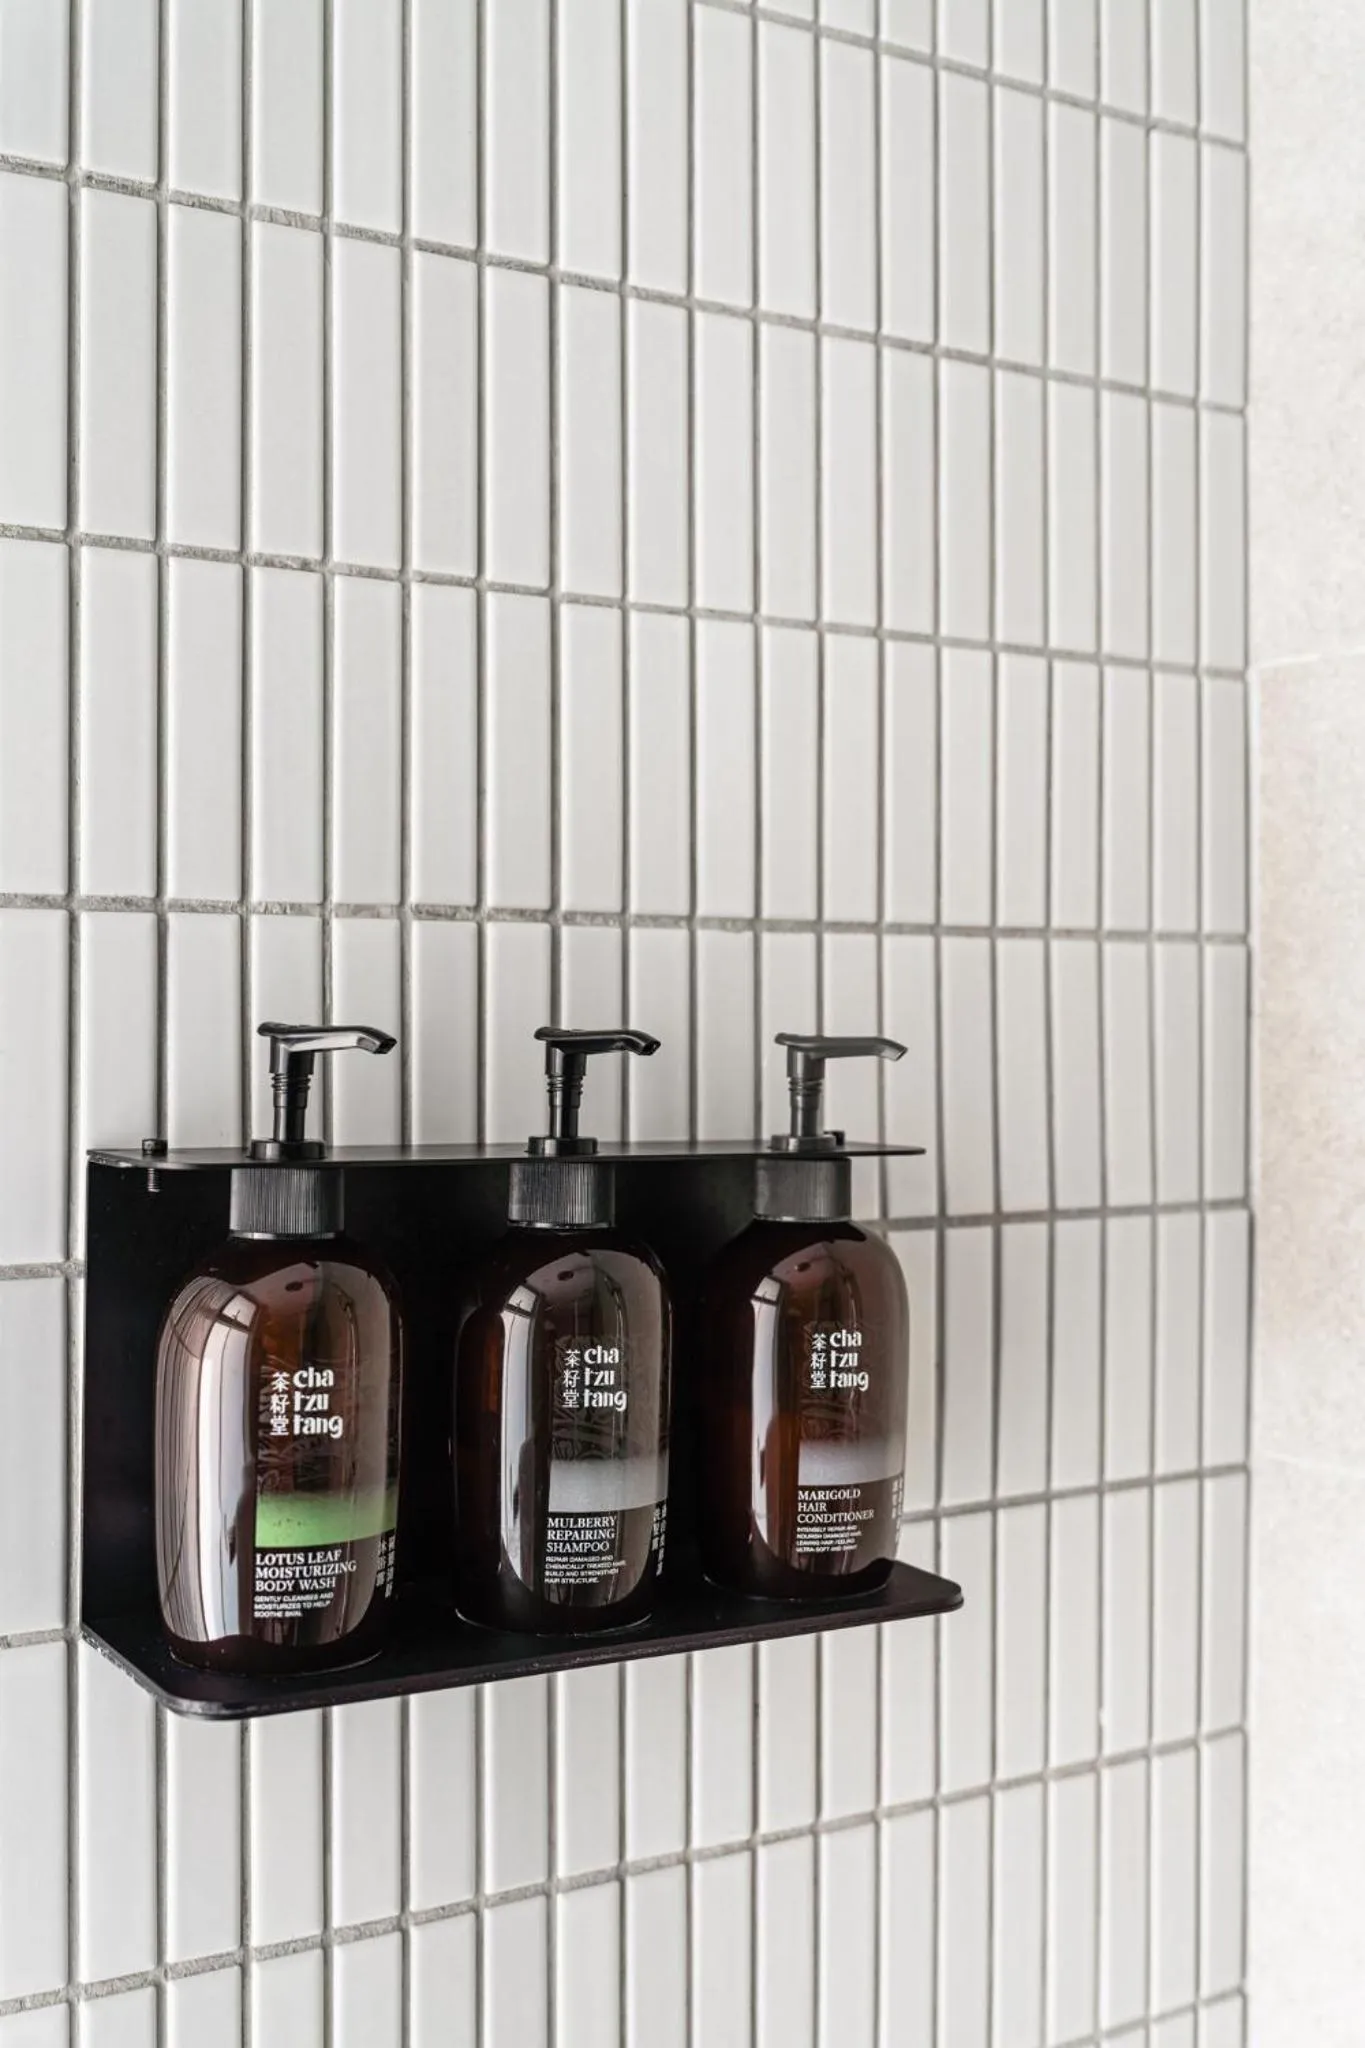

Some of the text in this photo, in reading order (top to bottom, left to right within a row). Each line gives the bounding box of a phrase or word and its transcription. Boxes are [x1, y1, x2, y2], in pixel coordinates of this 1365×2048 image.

[829, 1329, 863, 1348] cha
[583, 1345, 620, 1365] cha
[292, 1366, 334, 1389] cha
[797, 1488, 861, 1501] MARIGOLD
[797, 1501, 828, 1513] HAIR
[547, 1515, 617, 1529] MULBERRY
[796, 1508, 875, 1524] CONDITIONER
[547, 1528, 616, 1541] REPAIRING
[546, 1541, 610, 1553] SHAMPOO
[255, 1549, 342, 1566] LOTUS LEAF
[255, 1560, 357, 1580] MOISTURIZING
[255, 1577, 336, 1593] BODY WASH
